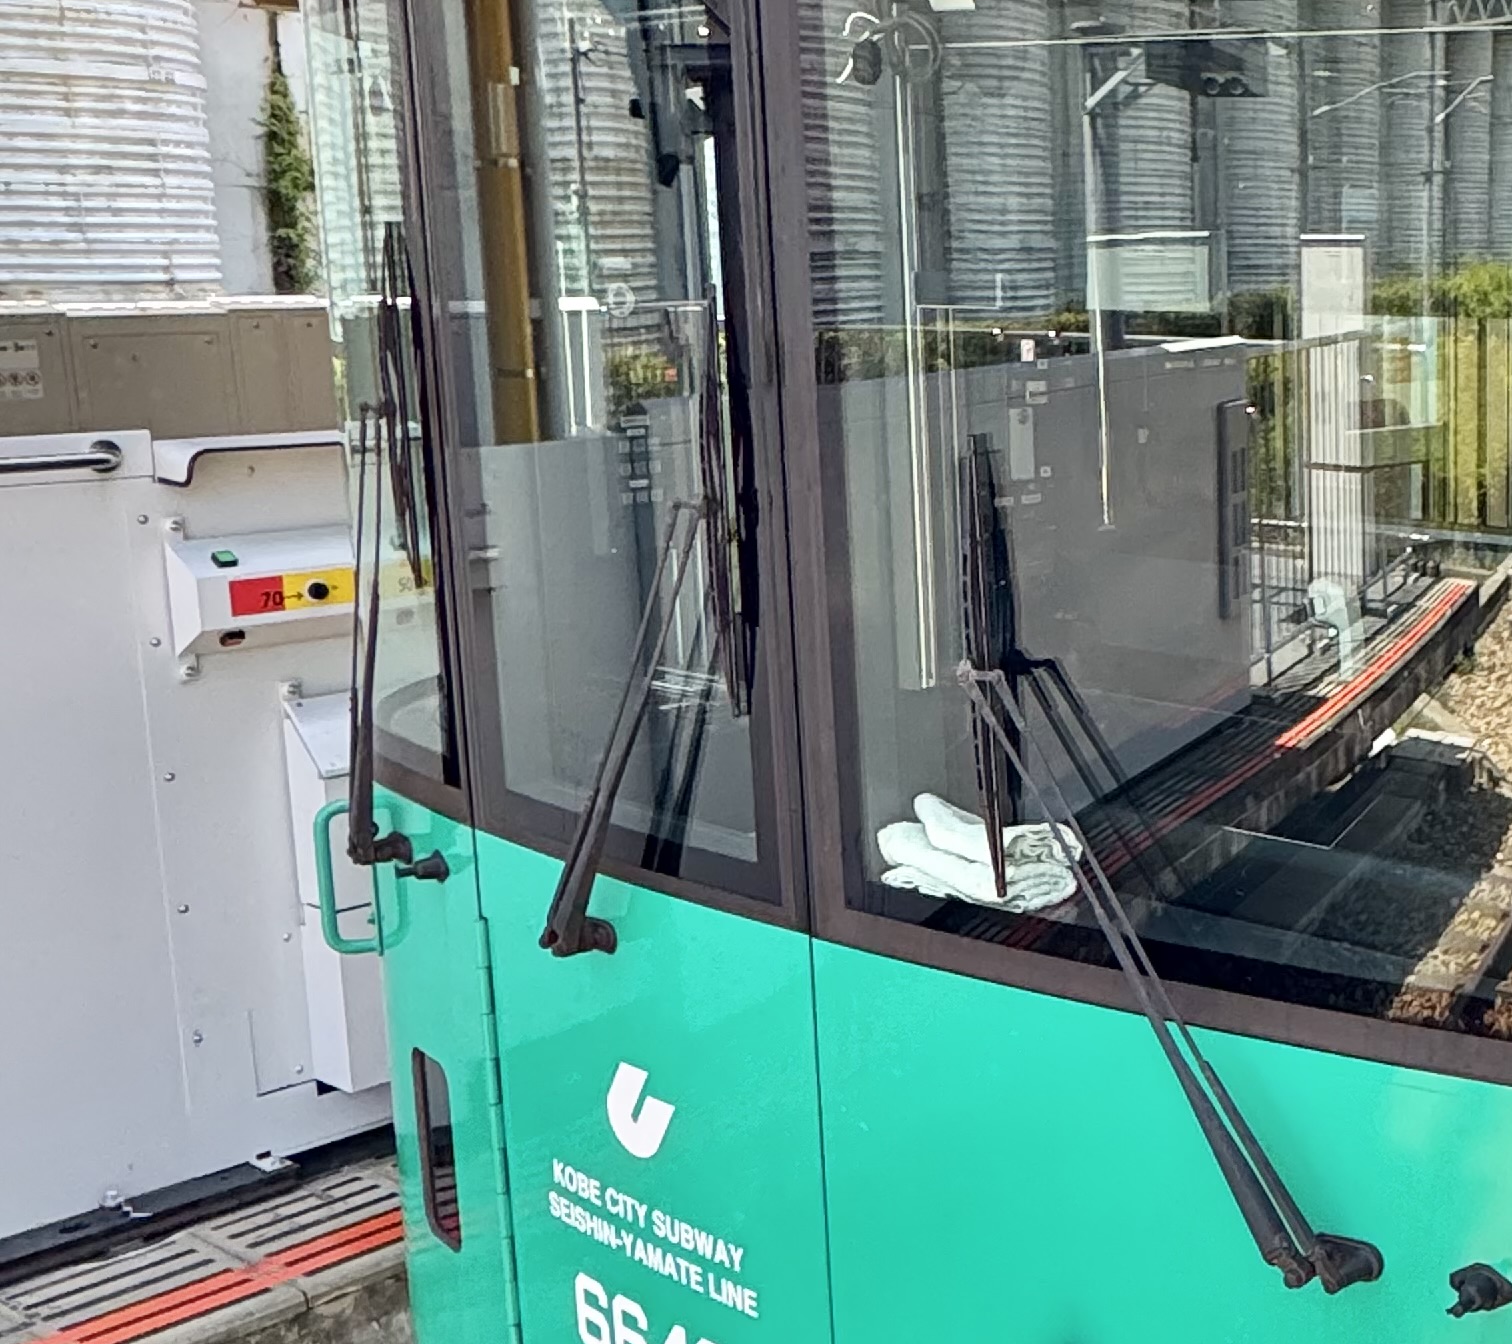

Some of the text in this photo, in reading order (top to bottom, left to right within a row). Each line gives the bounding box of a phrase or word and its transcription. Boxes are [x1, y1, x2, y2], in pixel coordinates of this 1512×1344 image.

[548, 1191, 760, 1318] SEISHIN-YAMATE LINE
[552, 1158, 744, 1272] KOBE CITY SUBWAY
